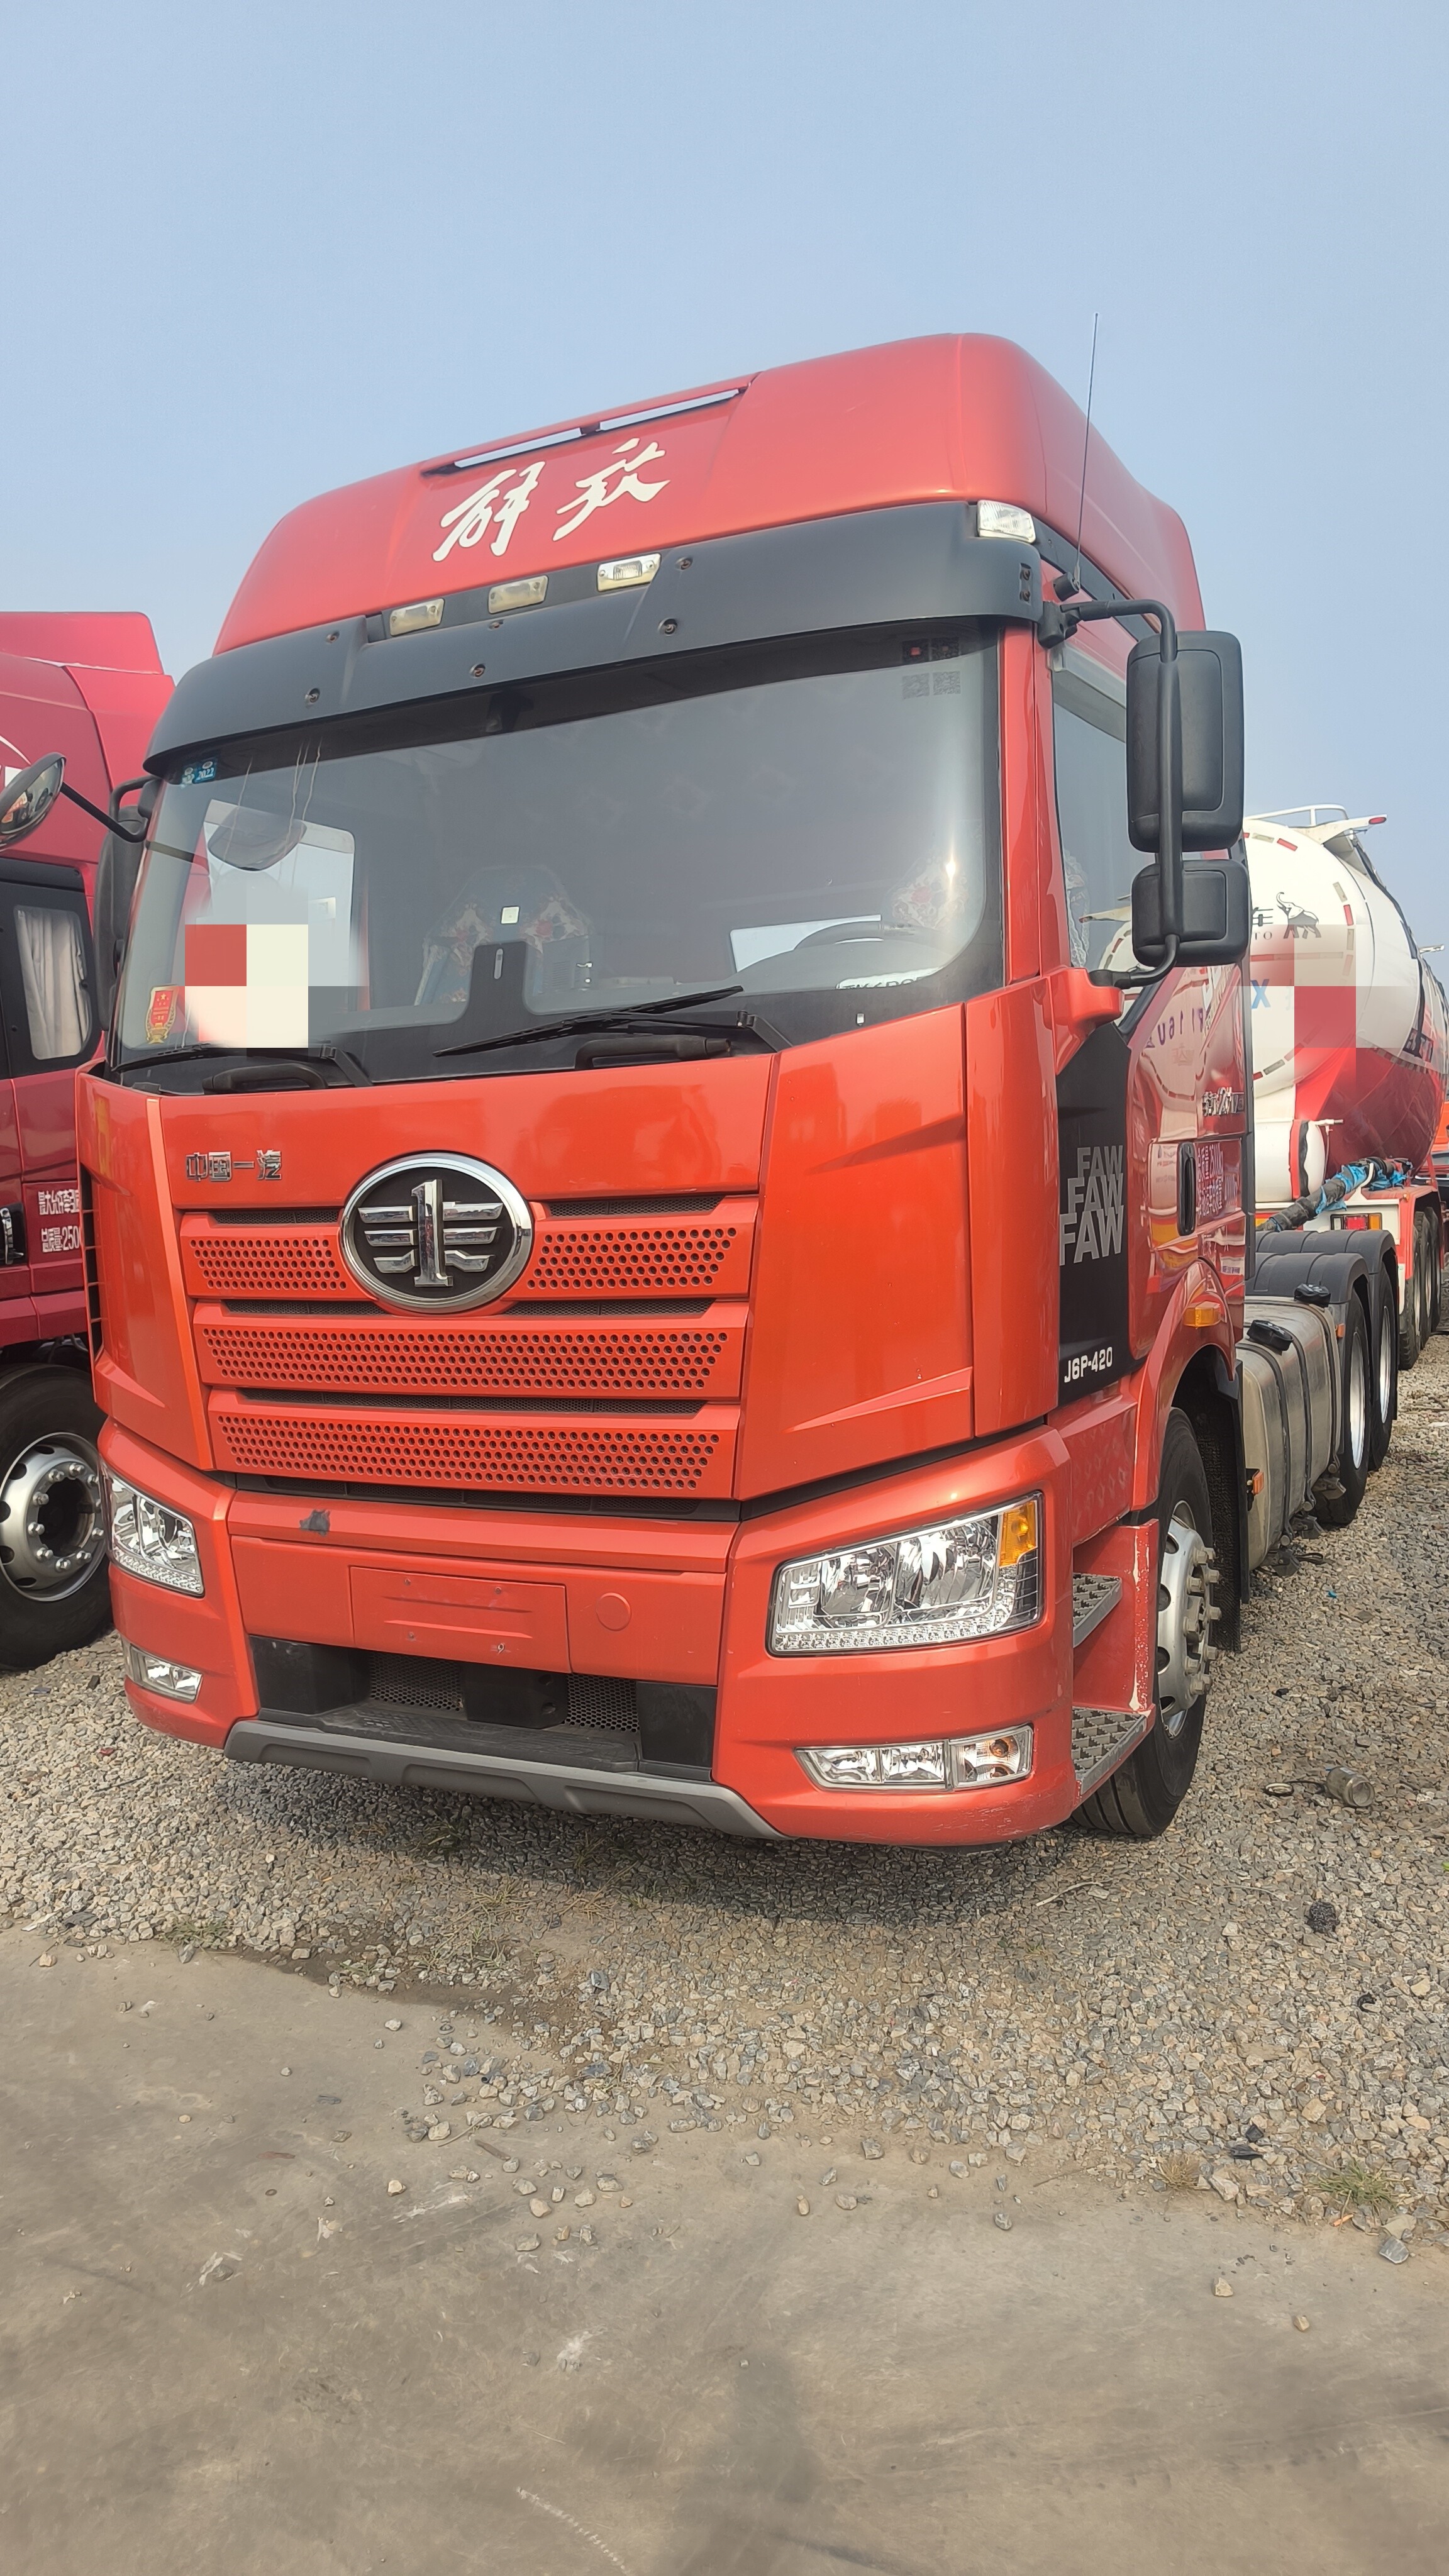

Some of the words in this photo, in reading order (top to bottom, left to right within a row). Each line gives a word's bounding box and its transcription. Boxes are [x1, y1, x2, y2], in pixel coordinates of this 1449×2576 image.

[432, 438, 671, 562] 解放
[186, 1149, 282, 1182] 中国一汽
[1077, 1145, 1123, 1181] FAW
[1067, 1173, 1124, 1216] FAW
[1059, 1204, 1124, 1267] FAW
[1064, 1346, 1113, 1383] J6P-420
